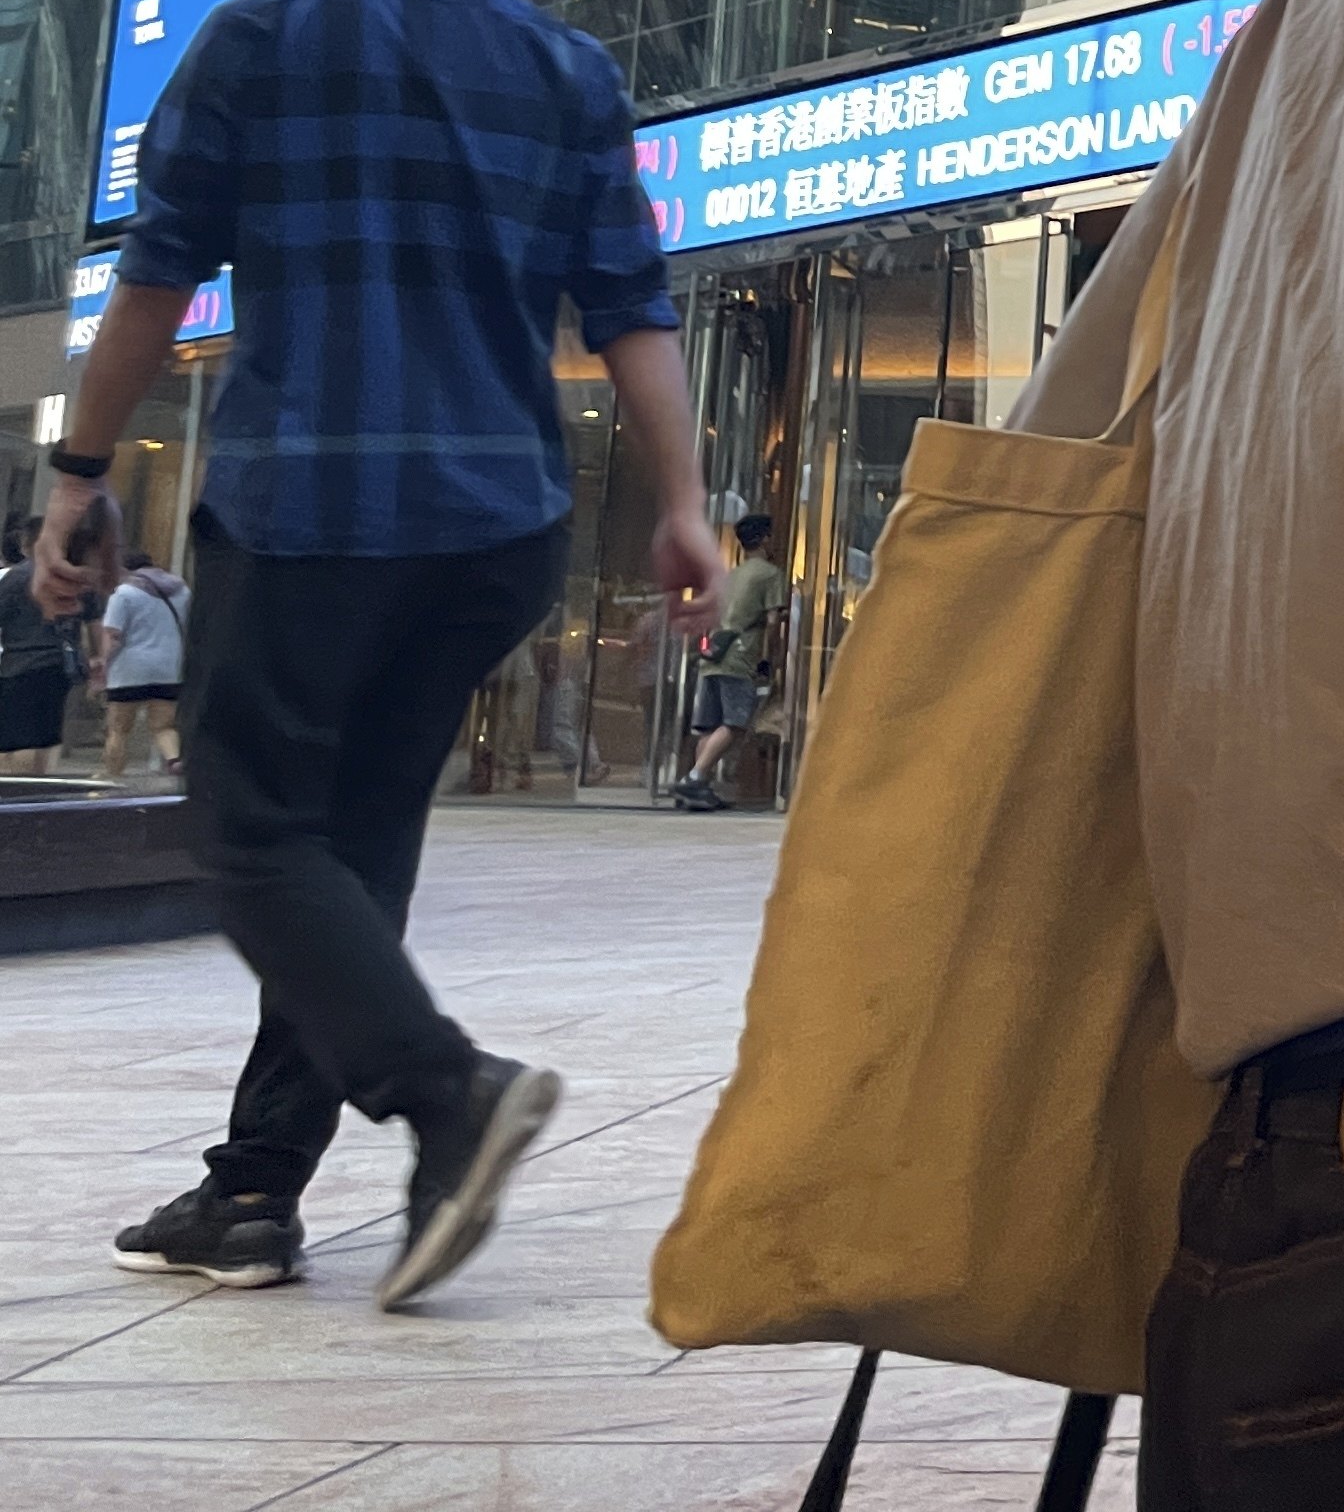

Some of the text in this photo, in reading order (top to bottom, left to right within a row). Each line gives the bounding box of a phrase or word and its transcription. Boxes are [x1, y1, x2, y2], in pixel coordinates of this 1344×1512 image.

[984, 50, 1054, 104] GEM
[1064, 30, 1142, 87] 17.68
[705, 178, 777, 228] 00012
[916, 112, 1105, 187] HENDERSON
[1109, 94, 1198, 151] LAND
